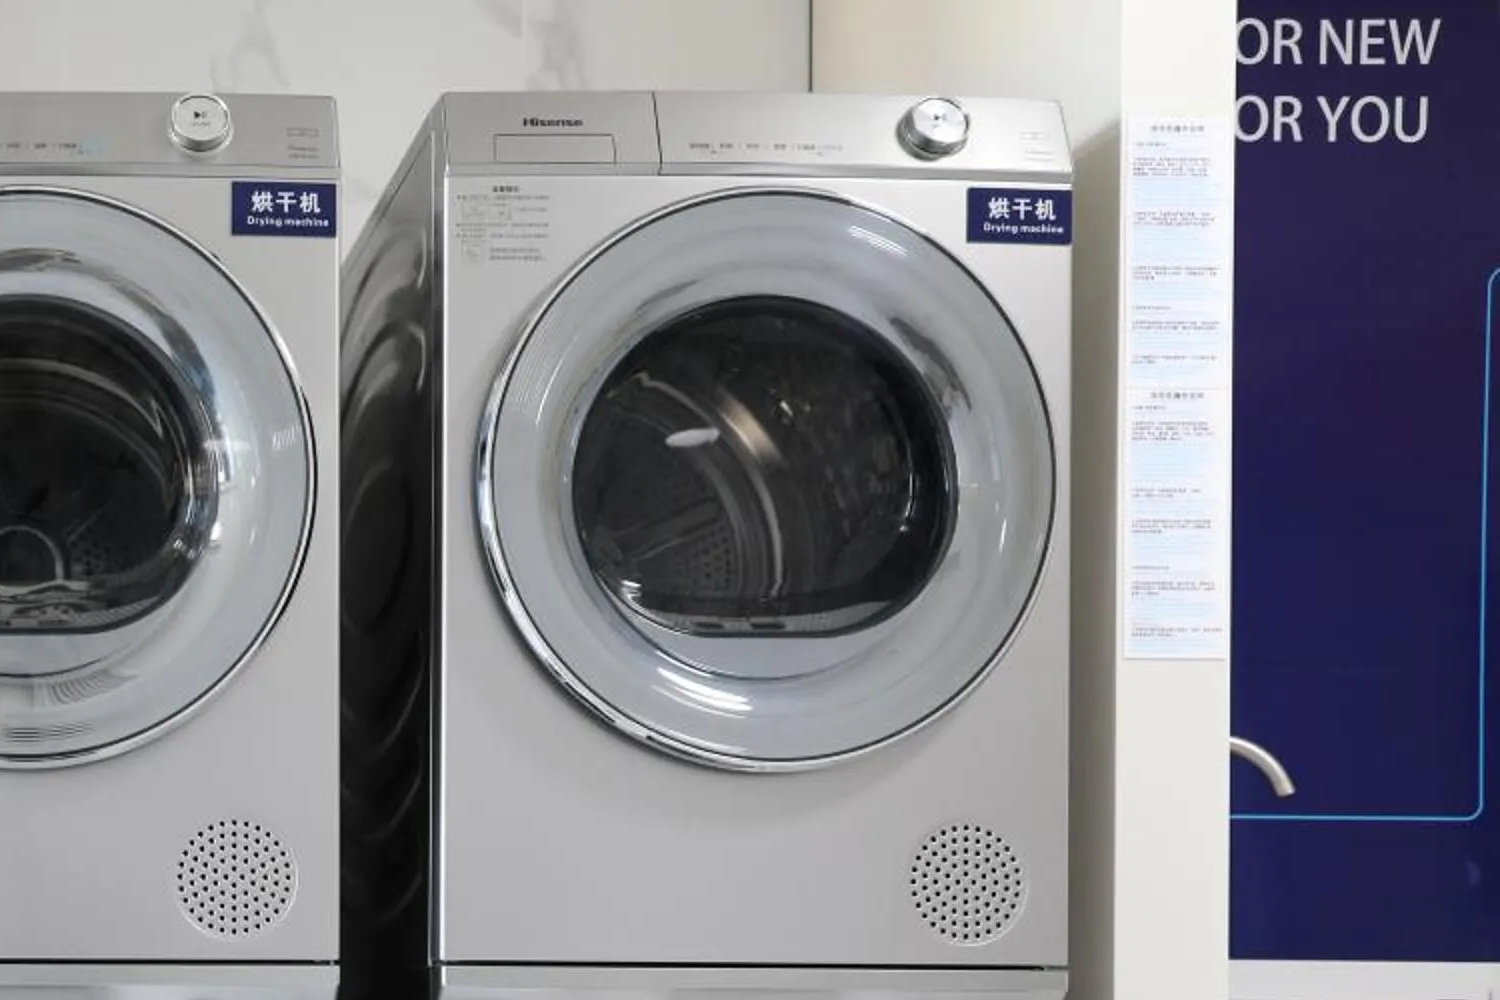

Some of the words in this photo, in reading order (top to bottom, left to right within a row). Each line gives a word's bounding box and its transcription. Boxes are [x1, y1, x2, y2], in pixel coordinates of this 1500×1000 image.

[1319, 18, 1441, 65] NEW
[522, 117, 583, 127] Hisense
[1316, 95, 1429, 143] YOU
[251, 190, 321, 213] 烘干机
[988, 197, 1056, 221] 烘干机
[247, 215, 282, 228] Drying
[983, 221, 1018, 235] Drying
[1020, 223, 1064, 235] machine
